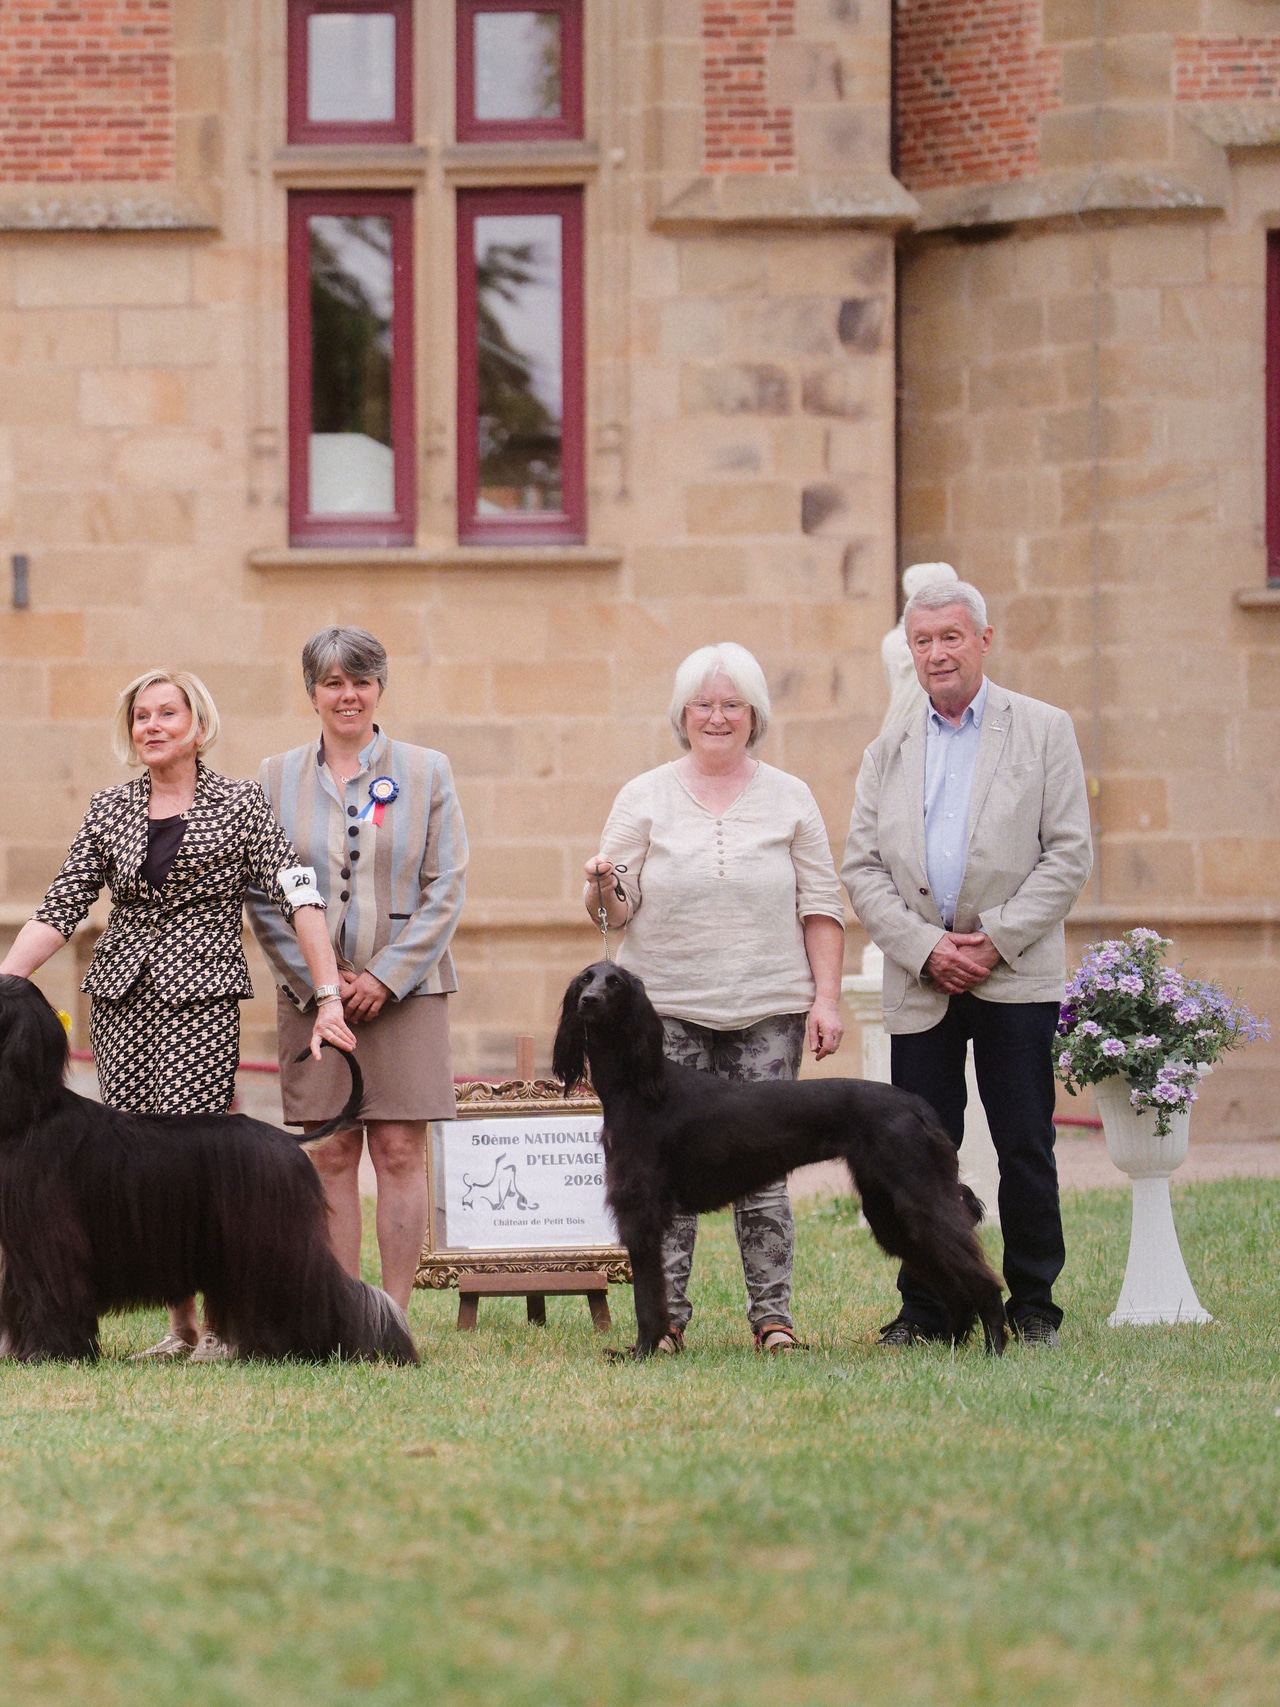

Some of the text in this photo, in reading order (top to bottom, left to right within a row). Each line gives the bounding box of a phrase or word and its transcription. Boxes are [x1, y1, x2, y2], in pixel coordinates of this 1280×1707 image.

[292, 873, 311, 888] 26
[471, 1131, 602, 1146] 50ème NATIONALE
[526, 1153, 603, 1166] D'ELEVAGE
[564, 1174, 603, 1186] 2026
[493, 1218, 528, 1227] Château
[543, 1217, 564, 1225] Petit
[566, 1217, 585, 1225] Bois
